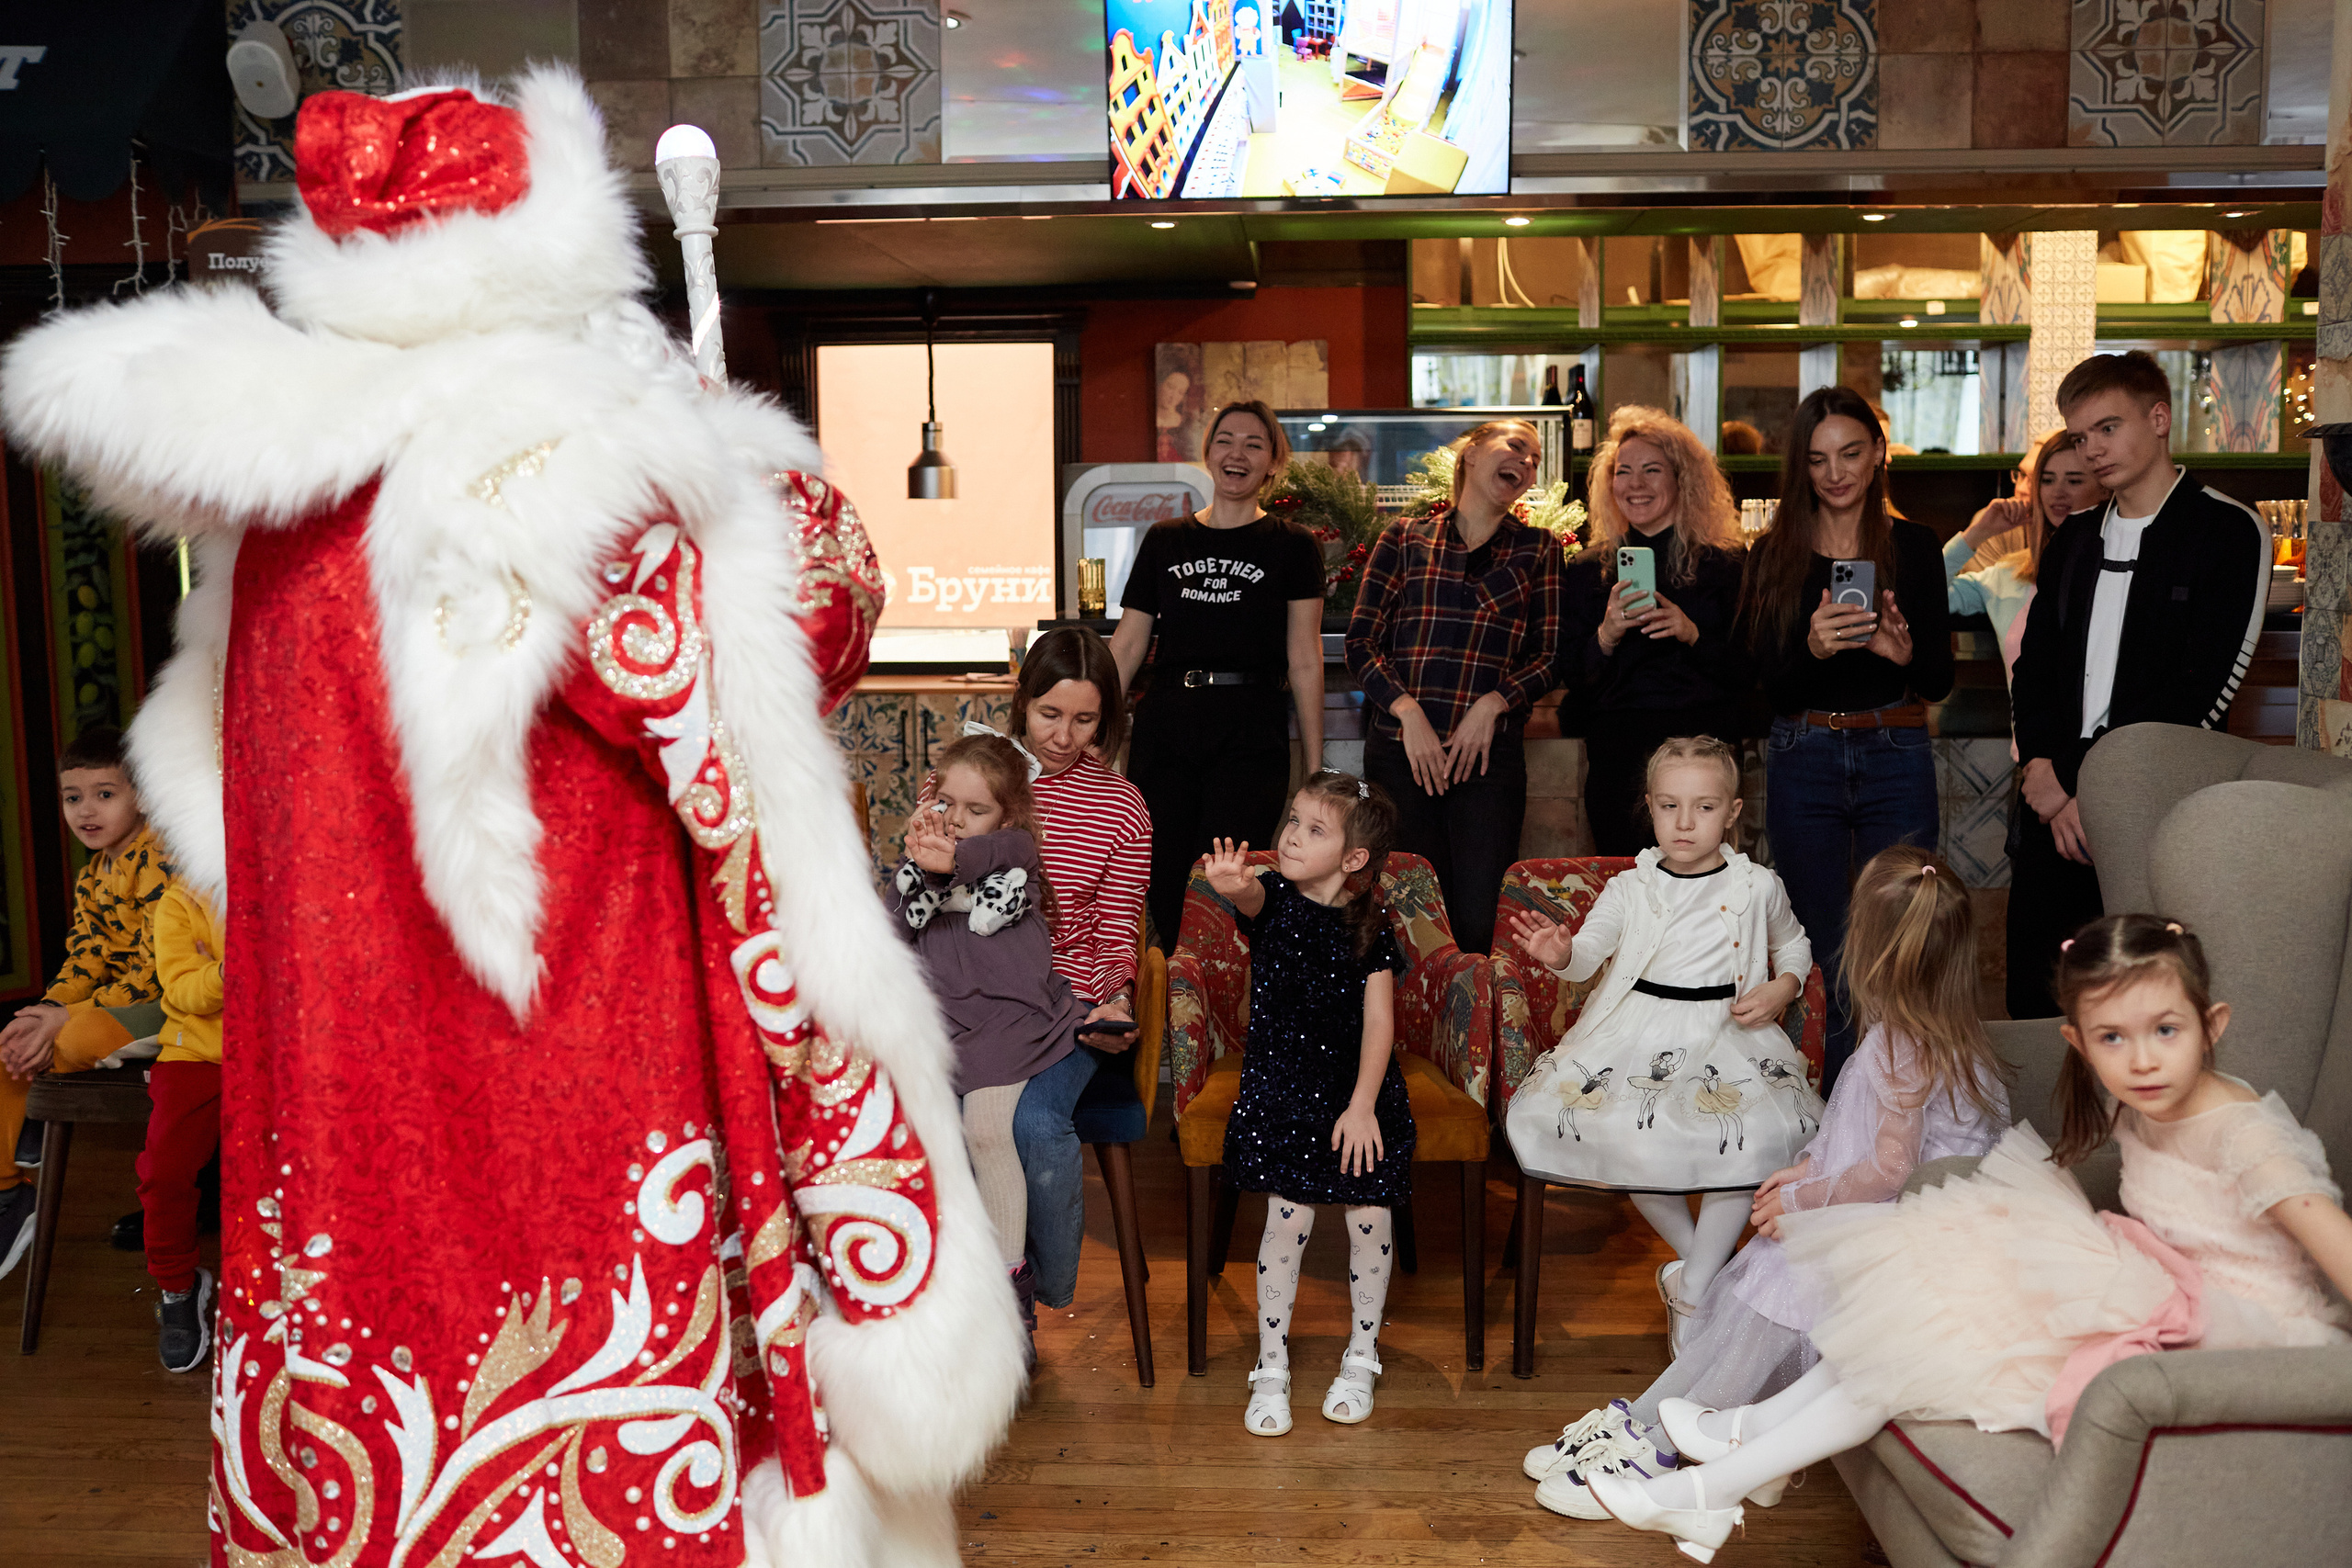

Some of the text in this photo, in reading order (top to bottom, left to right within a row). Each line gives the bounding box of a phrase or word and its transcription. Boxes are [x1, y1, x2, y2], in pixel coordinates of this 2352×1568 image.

[967, 564, 1052, 577] семейное кафе
[1168, 557, 1265, 583] TOGETHER
[906, 566, 1052, 613] Бруни
[1203, 577, 1227, 590] FOR
[1181, 587, 1242, 604] ROMANCE
